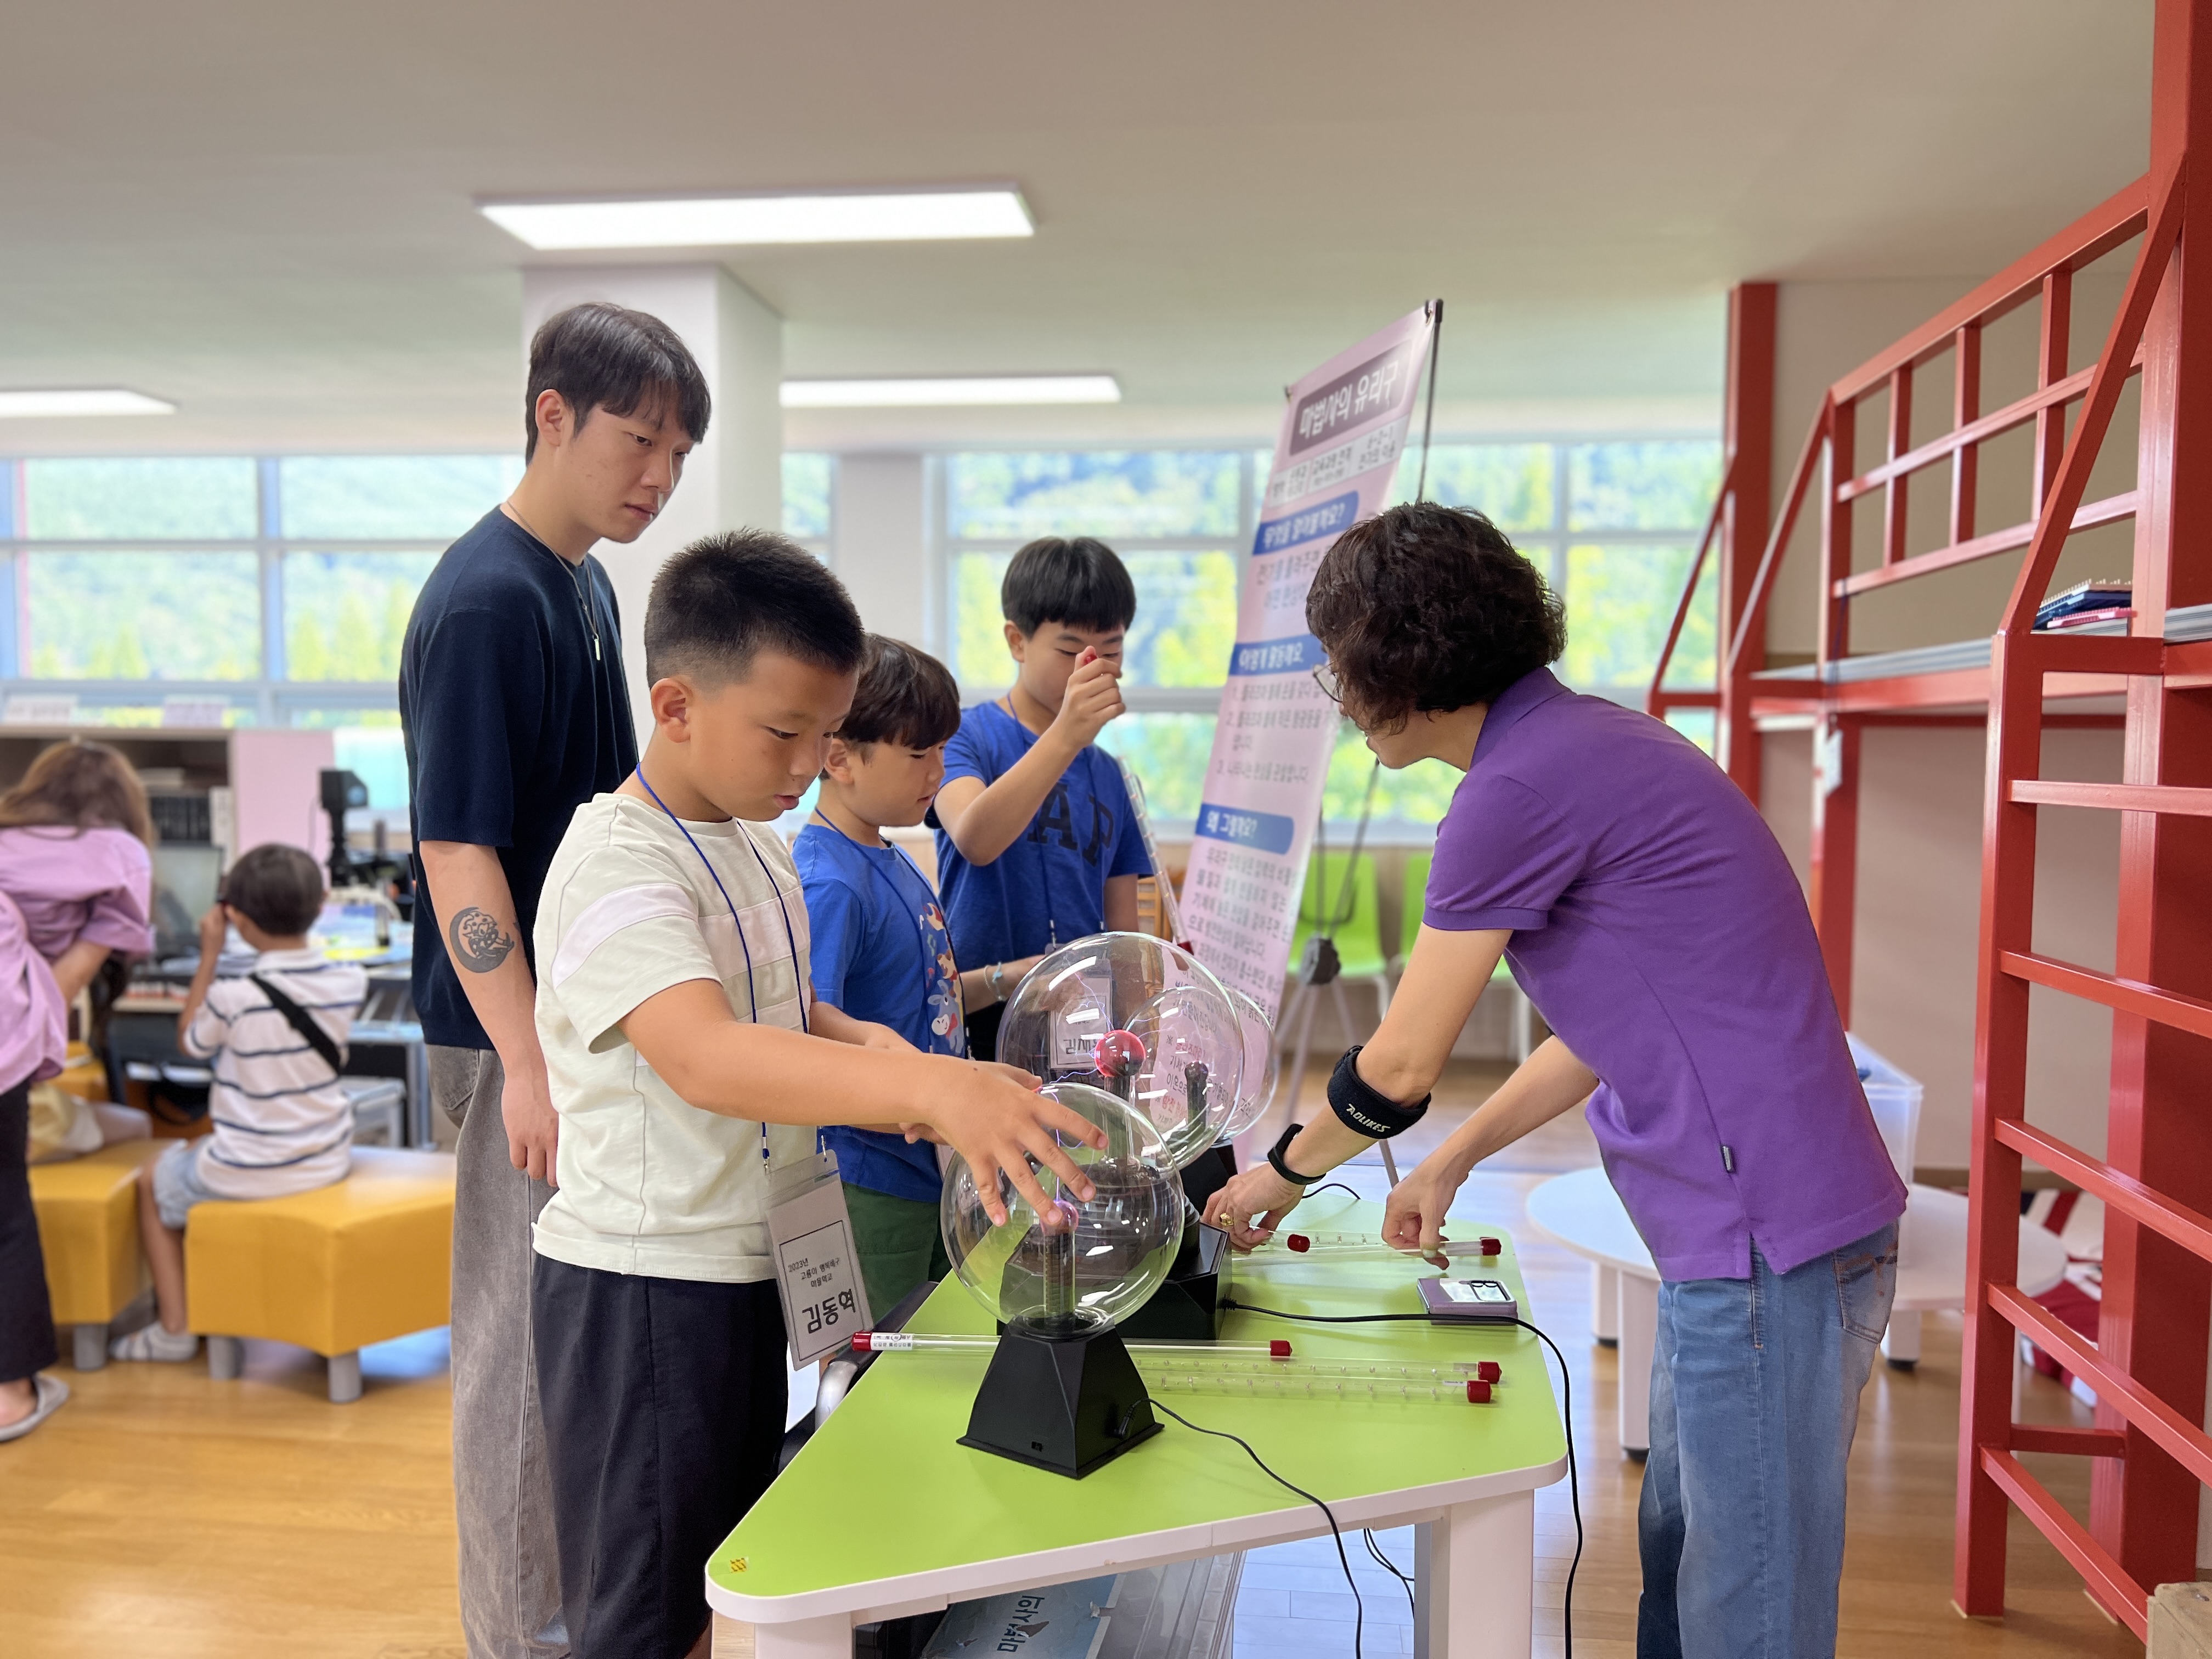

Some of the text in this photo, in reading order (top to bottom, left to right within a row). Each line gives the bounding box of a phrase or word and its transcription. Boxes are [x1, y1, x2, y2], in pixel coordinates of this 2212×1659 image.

[1353, 360, 1400, 416] 유리구
[1027, 782, 1114, 867] AP
[1205, 810, 1220, 833] 왜
[1346, 1104, 1391, 1132] AOLIKES
